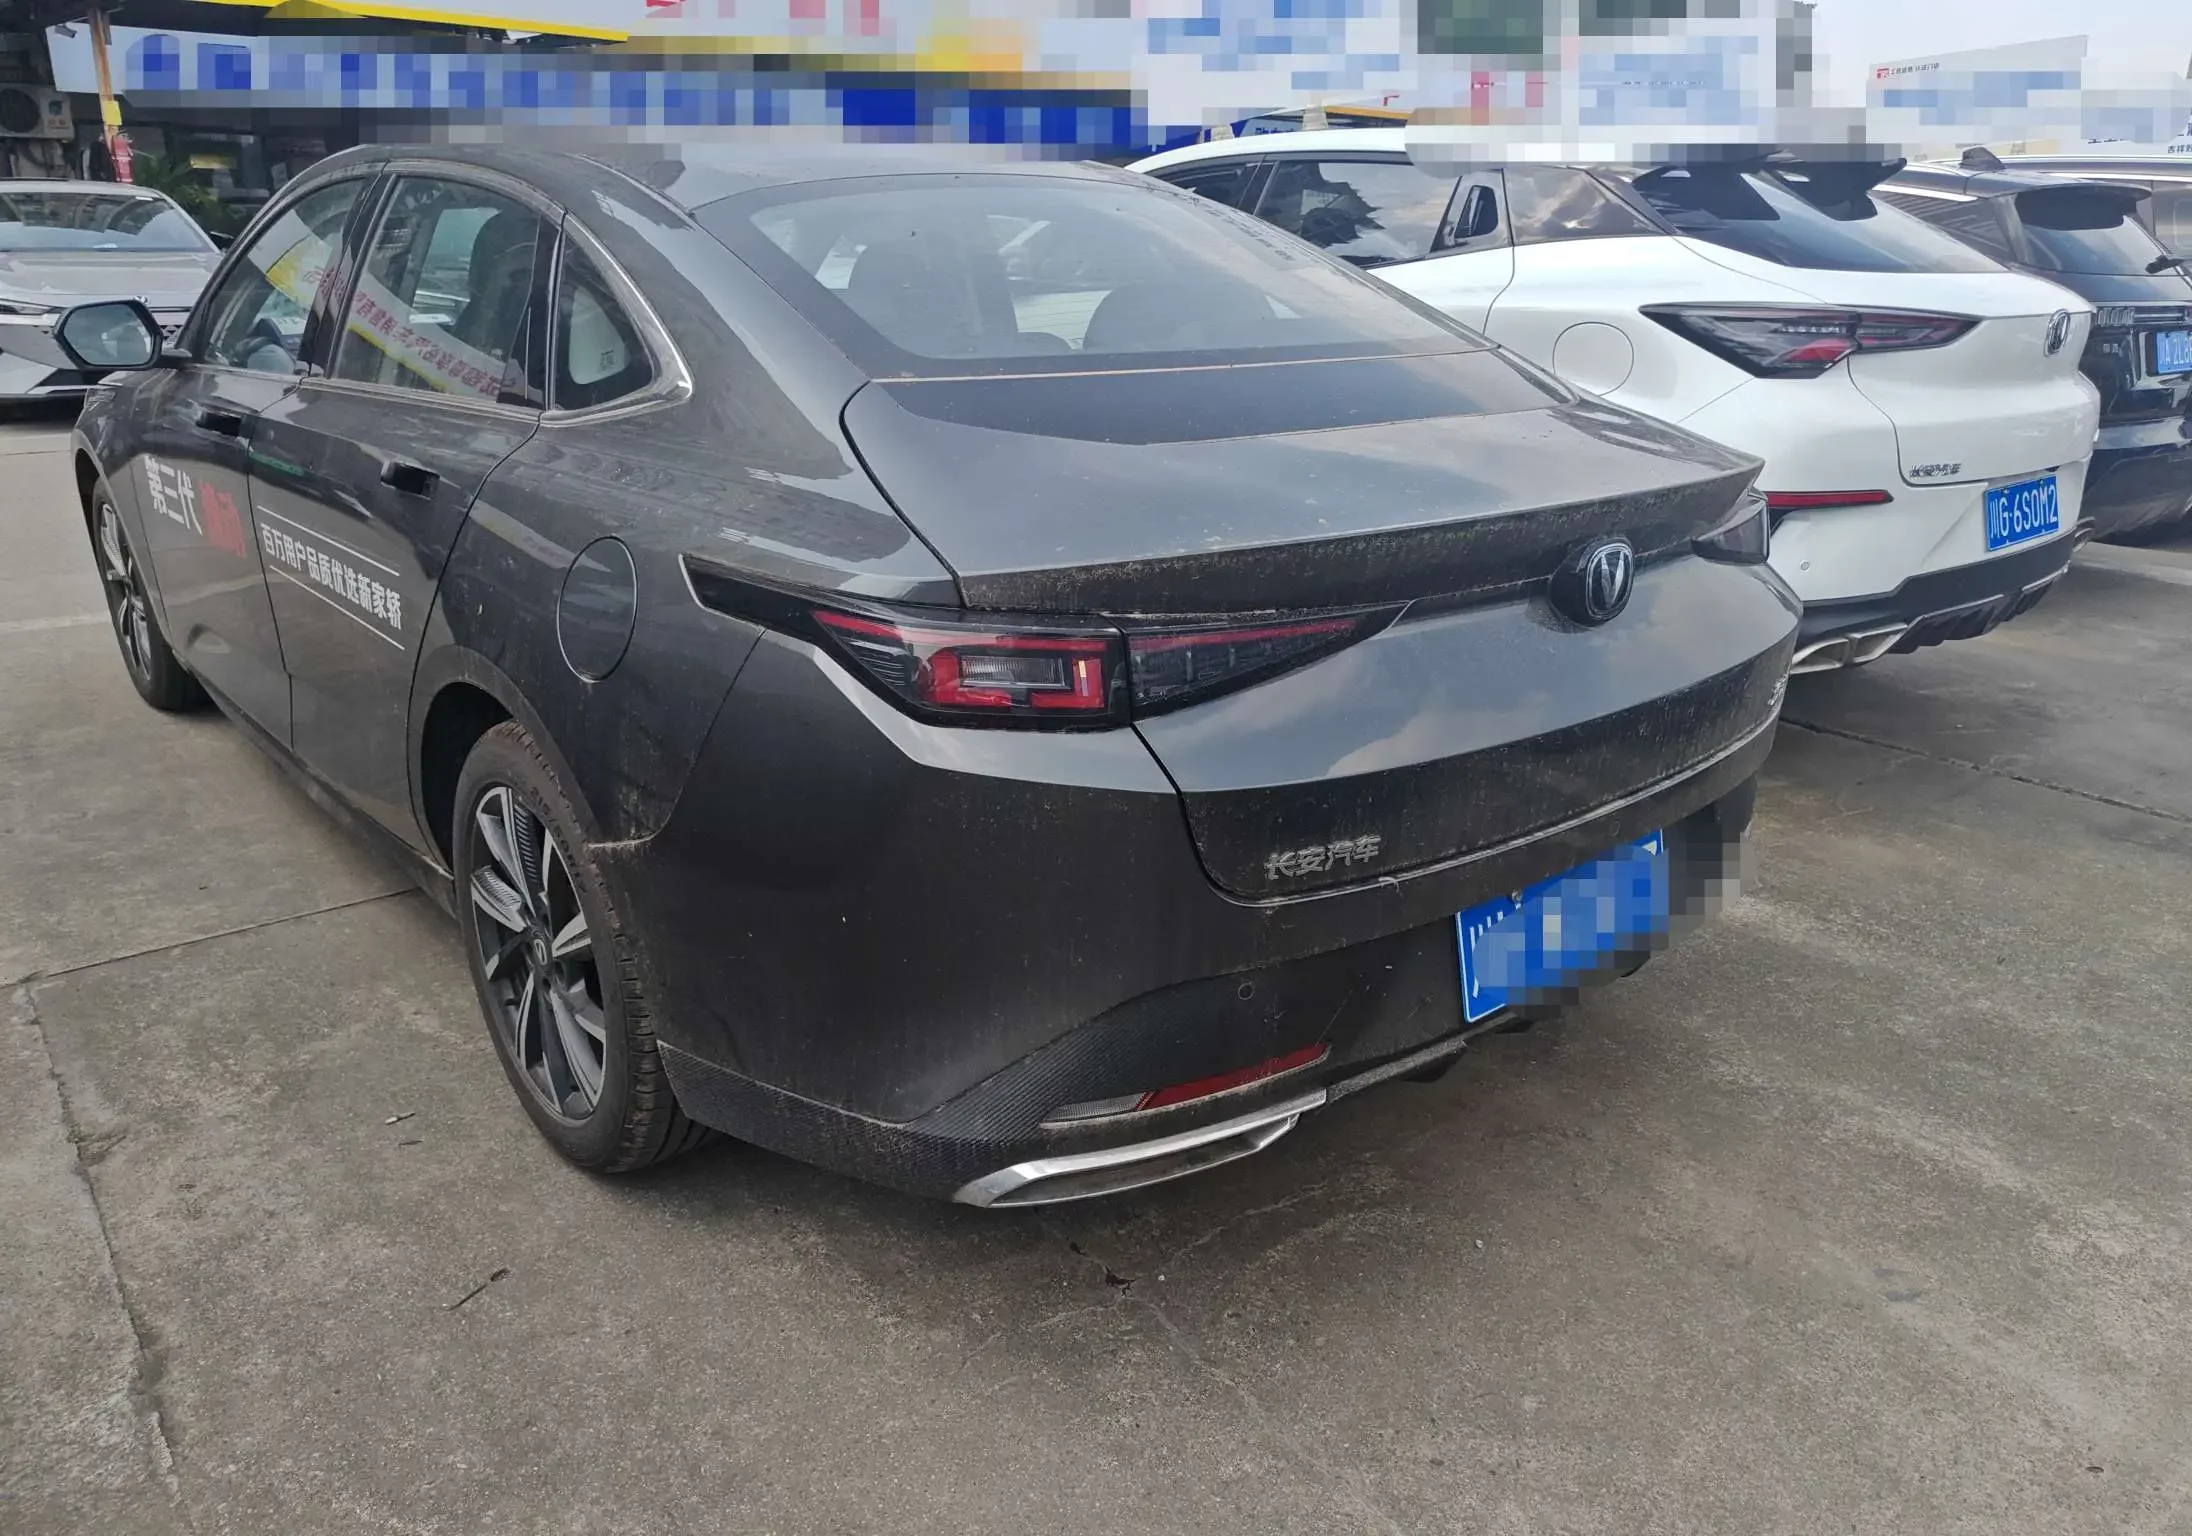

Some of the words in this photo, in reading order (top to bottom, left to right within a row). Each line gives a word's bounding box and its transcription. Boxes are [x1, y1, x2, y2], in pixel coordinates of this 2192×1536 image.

[144, 454, 203, 536] 第三代
[260, 523, 402, 630] 百万用户品质优选新家轿
[1263, 834, 1382, 881] 长安汽车
